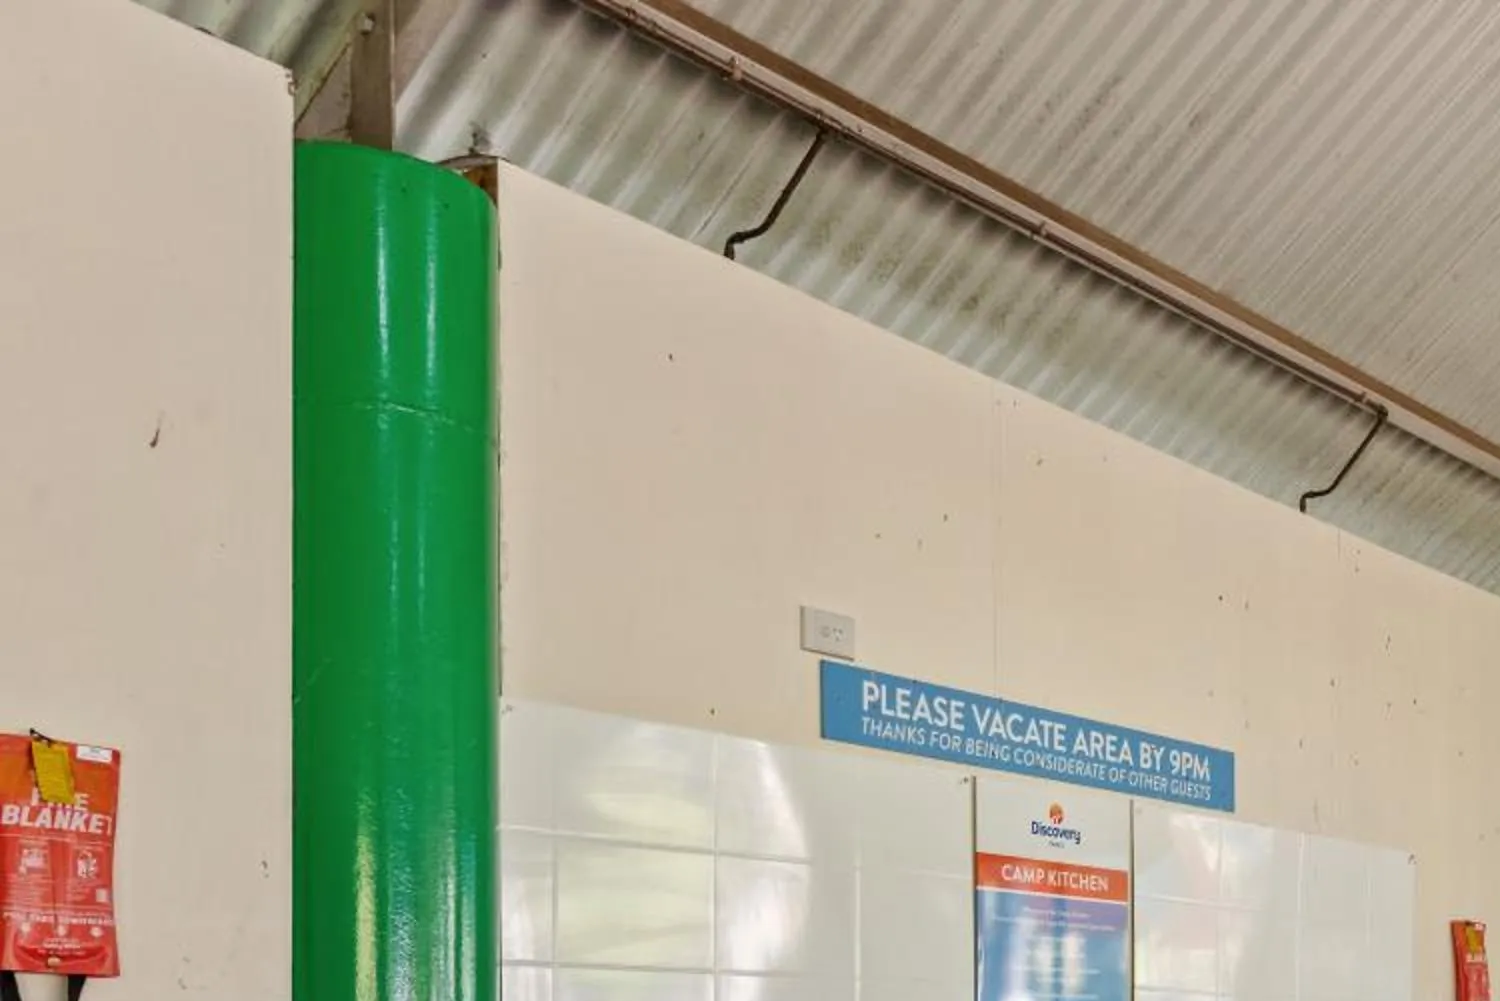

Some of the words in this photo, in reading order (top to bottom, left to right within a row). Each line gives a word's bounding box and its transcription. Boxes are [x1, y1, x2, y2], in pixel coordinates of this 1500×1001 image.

[862, 680, 965, 732] PLEASE
[972, 704, 1066, 752] VACATE
[1073, 728, 1134, 767] AREA
[1139, 743, 1166, 773] BY
[1170, 750, 1211, 783] 9PM
[862, 717, 926, 746] THANKS
[930, 731, 961, 753] FOR
[966, 738, 1010, 762] BEING
[1014, 748, 1106, 782] CONSIDERATE
[1109, 767, 1126, 783] OF
[1130, 771, 1168, 795] OTHER
[1171, 778, 1212, 801] GUESTS
[1031, 820, 1081, 845] Discovery
[1001, 864, 1045, 884] CAMP
[1047, 870, 1109, 892] KITCHEN
